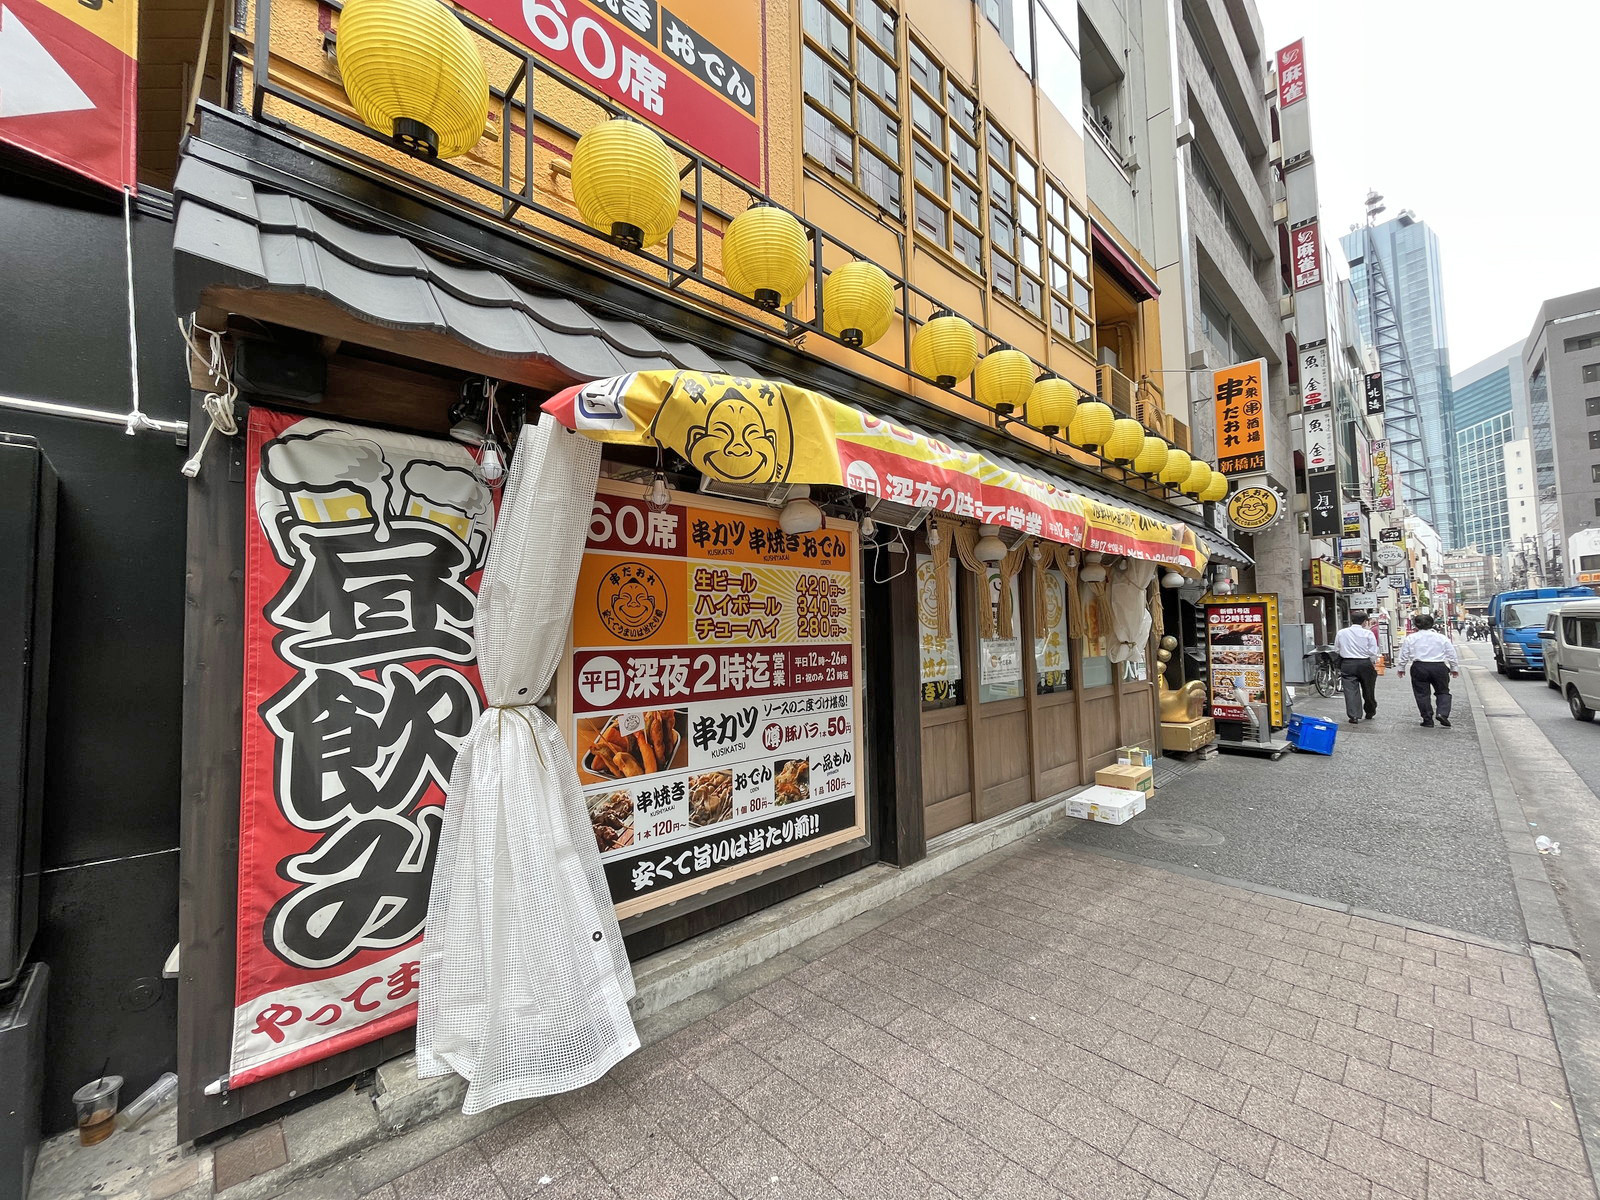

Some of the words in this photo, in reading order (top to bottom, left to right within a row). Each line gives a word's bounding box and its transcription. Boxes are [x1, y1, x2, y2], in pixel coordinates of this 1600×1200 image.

[522, 0, 667, 116] 60席
[665, 20, 751, 106] おでん
[1281, 62, 1304, 104] 麻雀
[1297, 241, 1316, 272] 麻雀
[1305, 355, 1321, 392] 魚金
[1216, 377, 1244, 448] 串だおれ
[1308, 419, 1326, 457] 魚金
[1219, 455, 1265, 474] 新橋店
[1234, 489, 1271, 504] 串だおれ
[587, 500, 679, 549] 60席
[692, 518, 746, 549] 串カツ
[748, 527, 801, 555] 串焼き
[802, 535, 846, 558] おでん
[609, 566, 656, 587] 串だおれ
[694, 569, 758, 593] 生ビール
[694, 594, 782, 617] ハイボール
[695, 617, 780, 639] チューハイ
[581, 669, 622, 693] 平日
[626, 653, 770, 699] 深夜2時迄
[772, 652, 786, 688] 営業
[692, 705, 760, 752] 串カツ
[784, 721, 820, 743] 豚バラ
[711, 742, 747, 760] KUSIKATSU
[811, 749, 852, 773] 一品もん
[734, 765, 772, 791] おでん
[636, 781, 686, 814] 串焼き
[630, 813, 820, 892] 安くて旨いは当たり前!!
